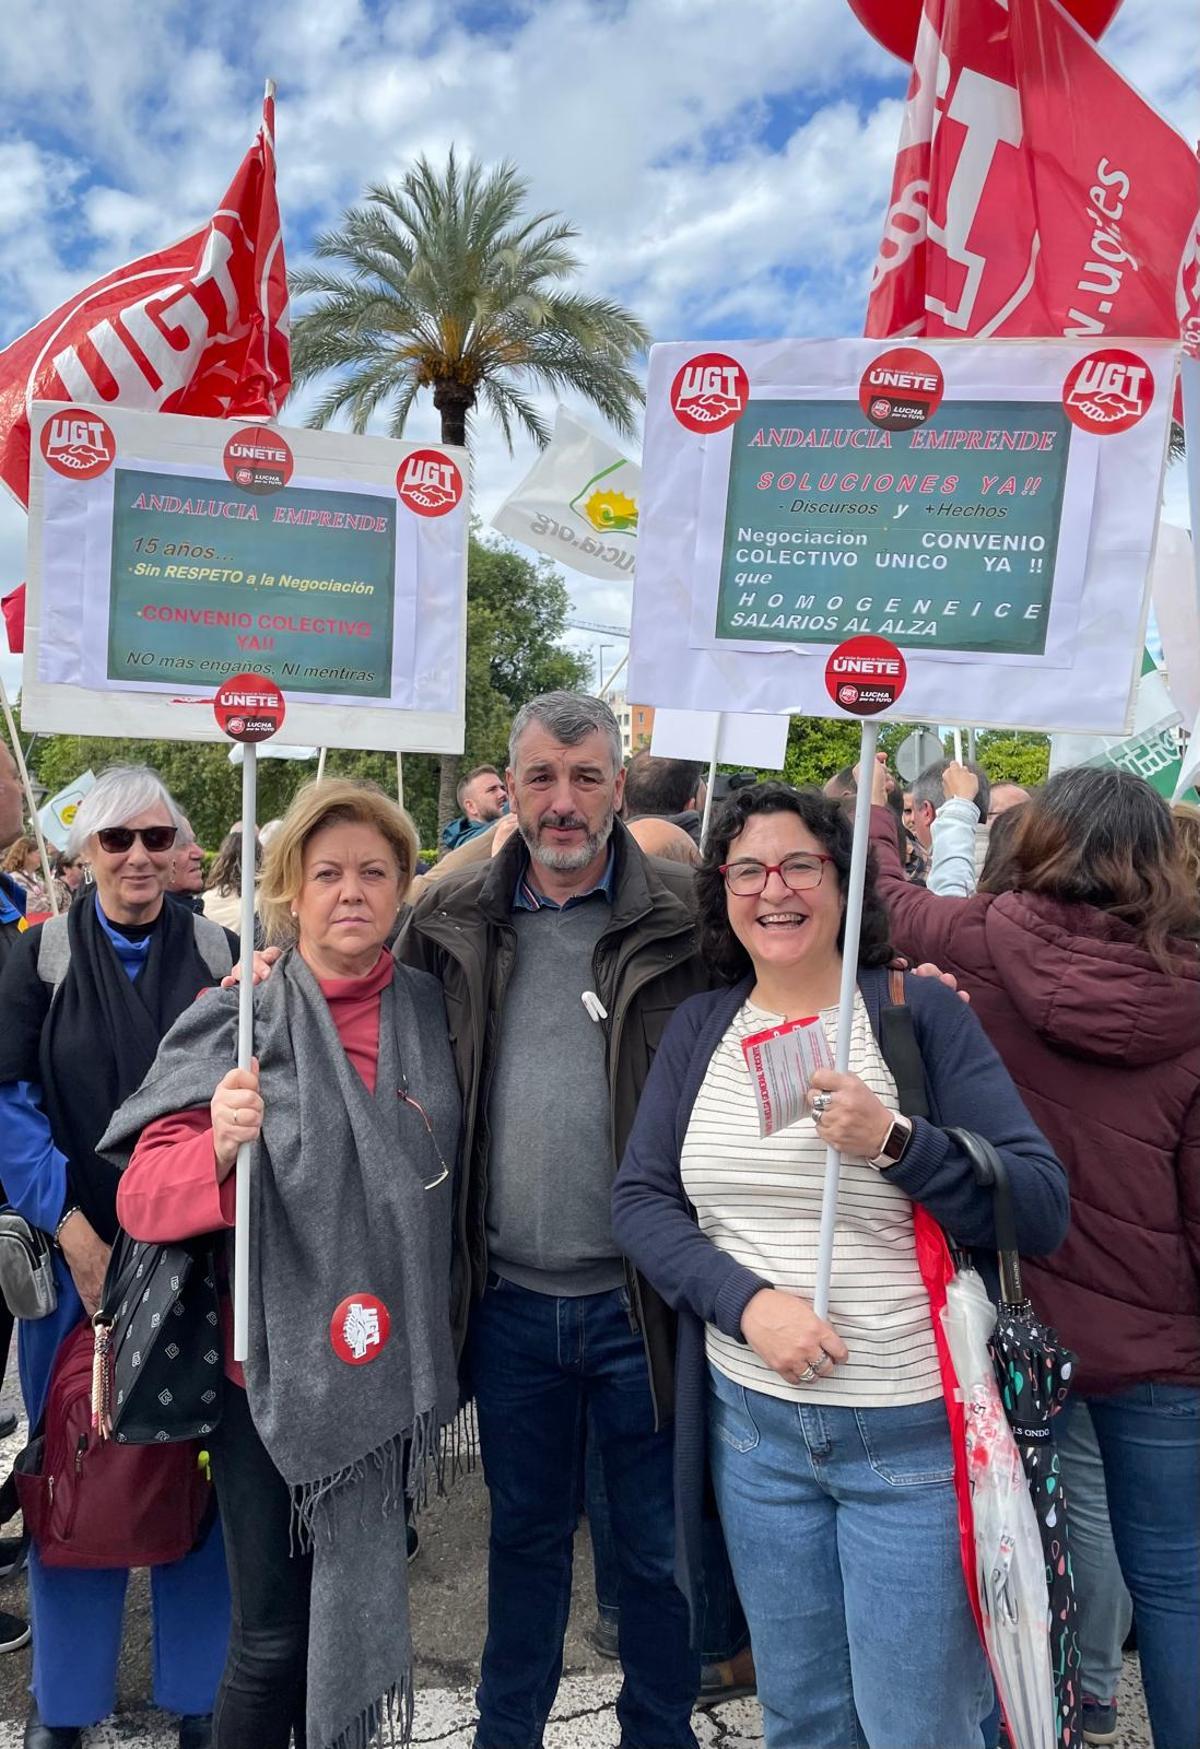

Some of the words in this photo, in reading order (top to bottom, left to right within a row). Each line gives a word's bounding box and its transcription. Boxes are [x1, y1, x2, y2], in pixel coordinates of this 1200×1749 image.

[680, 366, 740, 400] UGT
[869, 367, 938, 391] ÚNETE
[1074, 360, 1147, 401] UGT
[893, 406, 923, 415] LUCHA
[49, 419, 105, 450] UGT
[747, 427, 893, 449] ANDALUCIA
[909, 430, 1057, 452] EMPRENDE
[229, 443, 287, 462] ÚNETE
[254, 473, 280, 482] LUCHA
[404, 458, 455, 492] UGT
[756, 471, 960, 495] SOLUCIONES
[980, 475, 1042, 496] YA!!
[131, 492, 260, 521] ANDALUCIA
[272, 506, 388, 534] EMPRENDE
[790, 499, 879, 516] Discursos
[893, 502, 910, 520] y
[135, 537, 160, 554] 15
[921, 532, 1046, 552] CONVENIO
[736, 548, 859, 567] COLECTIVO
[982, 556, 1013, 573] YA
[133, 562, 161, 577] Sin
[163, 564, 244, 584] RESPETO
[246, 574, 257, 586] a
[260, 572, 275, 586] la
[278, 574, 374, 595] Negociación
[734, 571, 773, 588] que
[142, 603, 253, 629] CONVENIO
[257, 613, 373, 638] COLECTIVO
[730, 612, 839, 632] SALARIOS
[842, 617, 873, 634] AL
[877, 619, 938, 637] ALZA
[236, 634, 275, 651] YA!!
[126, 651, 155, 666] NO
[281, 662, 301, 676] NI
[303, 666, 376, 682] mentiras
[833, 656, 900, 675] ÚNETE
[220, 691, 279, 708] ÚNETE
